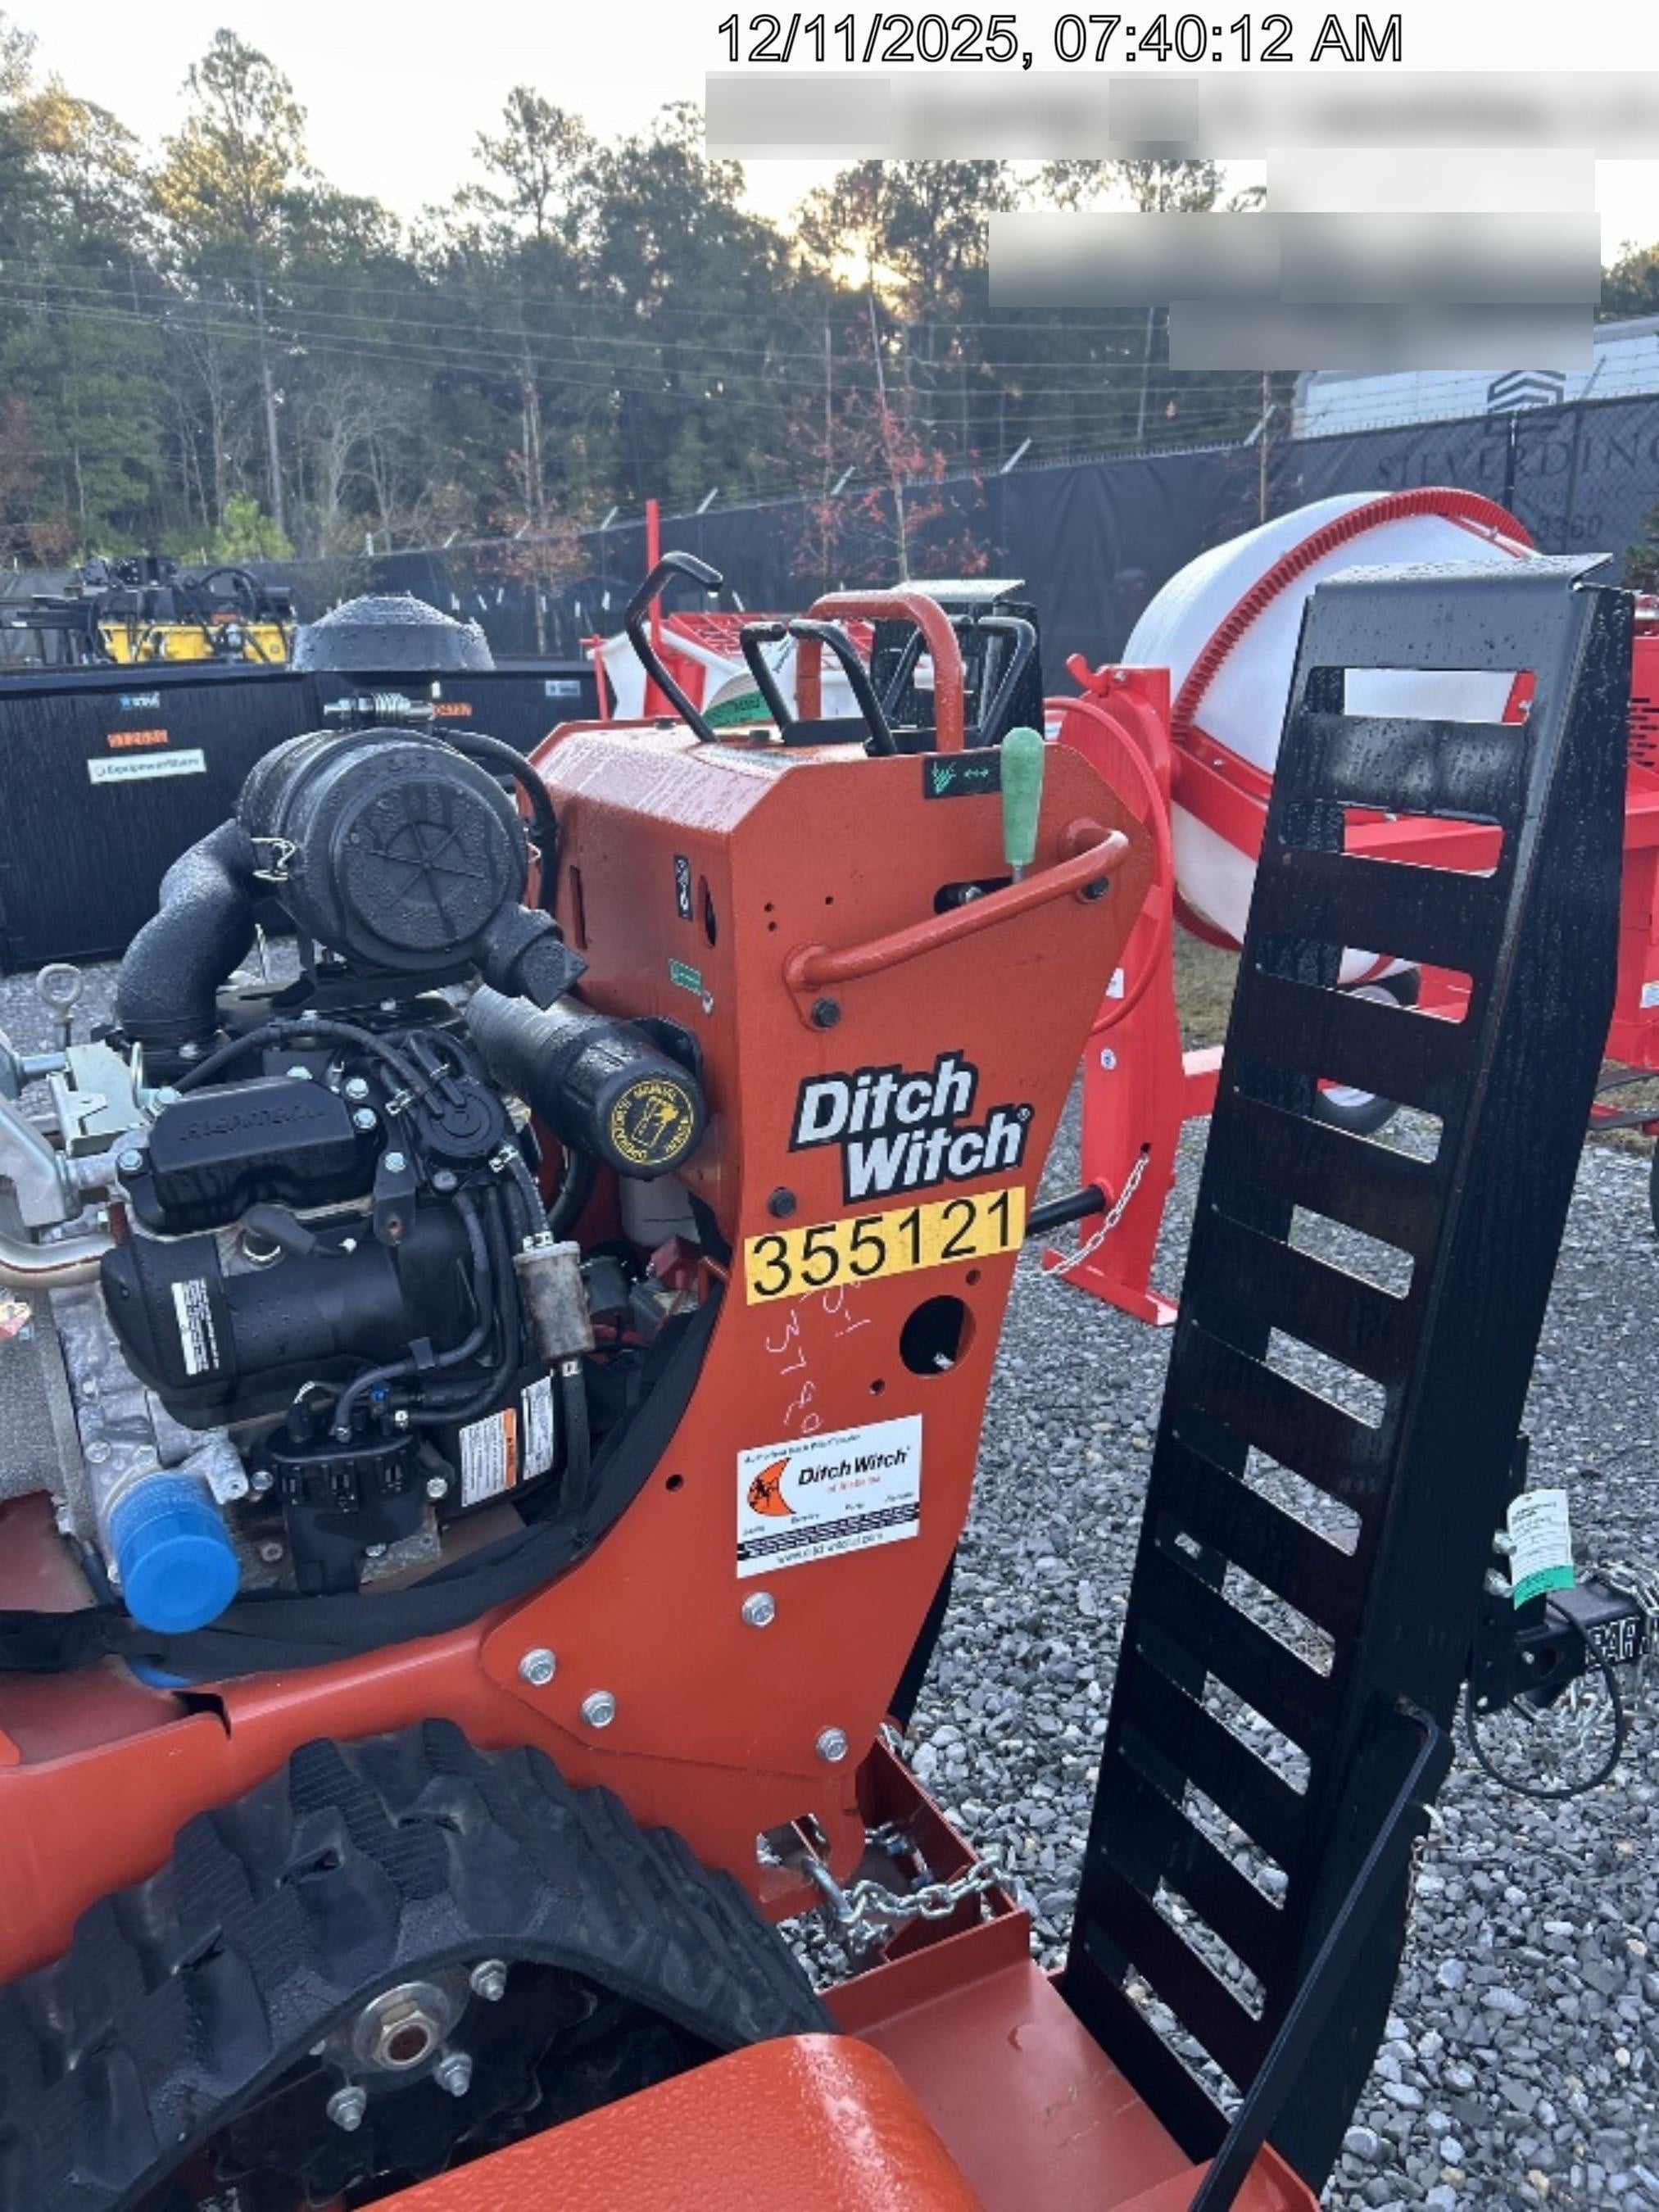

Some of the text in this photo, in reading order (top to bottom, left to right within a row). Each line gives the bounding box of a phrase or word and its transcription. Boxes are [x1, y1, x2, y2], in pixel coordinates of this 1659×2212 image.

[795, 1057, 974, 1145] Ditch
[847, 1110, 1024, 1199] Witch
[752, 1190, 1009, 1296] 355121
[798, 1459, 852, 1485] Ditch
[854, 1447, 909, 1473] Witch
